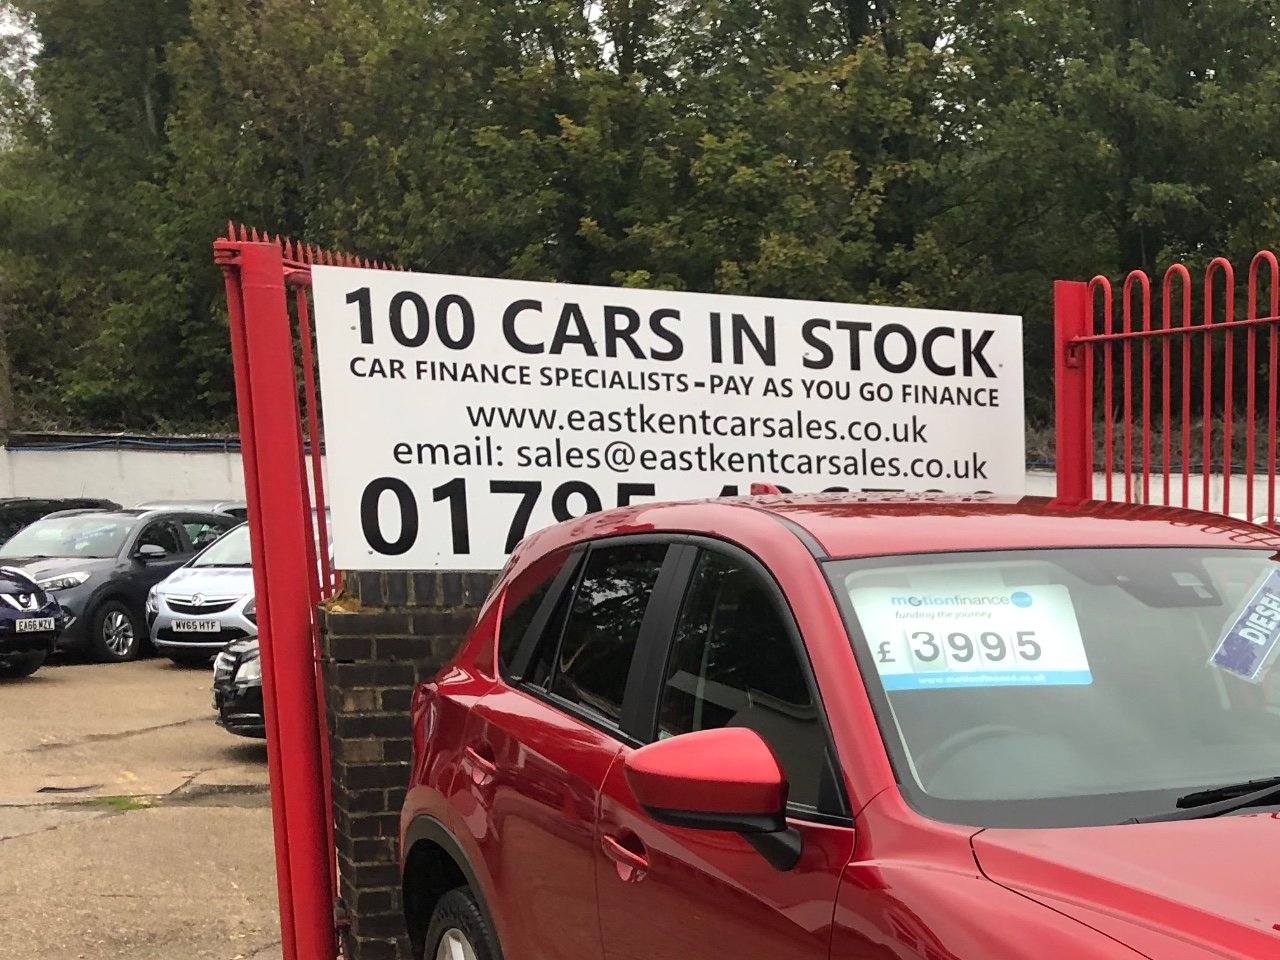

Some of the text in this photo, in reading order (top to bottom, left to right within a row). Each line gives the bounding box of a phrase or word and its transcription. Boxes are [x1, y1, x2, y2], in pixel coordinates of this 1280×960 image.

[345, 287, 998, 379] 100 CARS IN STOCK
[349, 356, 407, 380] CAR
[415, 360, 532, 386] FINANCE
[762, 377, 793, 398] AS
[801, 378, 851, 401] YOU
[859, 382, 894, 403] GO
[901, 384, 1000, 408] FINANCE
[466, 403, 928, 443] www.eastkentcarsales.co.uk
[393, 435, 988, 480] email: sales@eastkentcarsales.co.uk
[175, 621, 216, 630] MV65 HTF
[895, 610, 992, 620] funding the journey
[877, 631, 1042, 663] £ 3995
